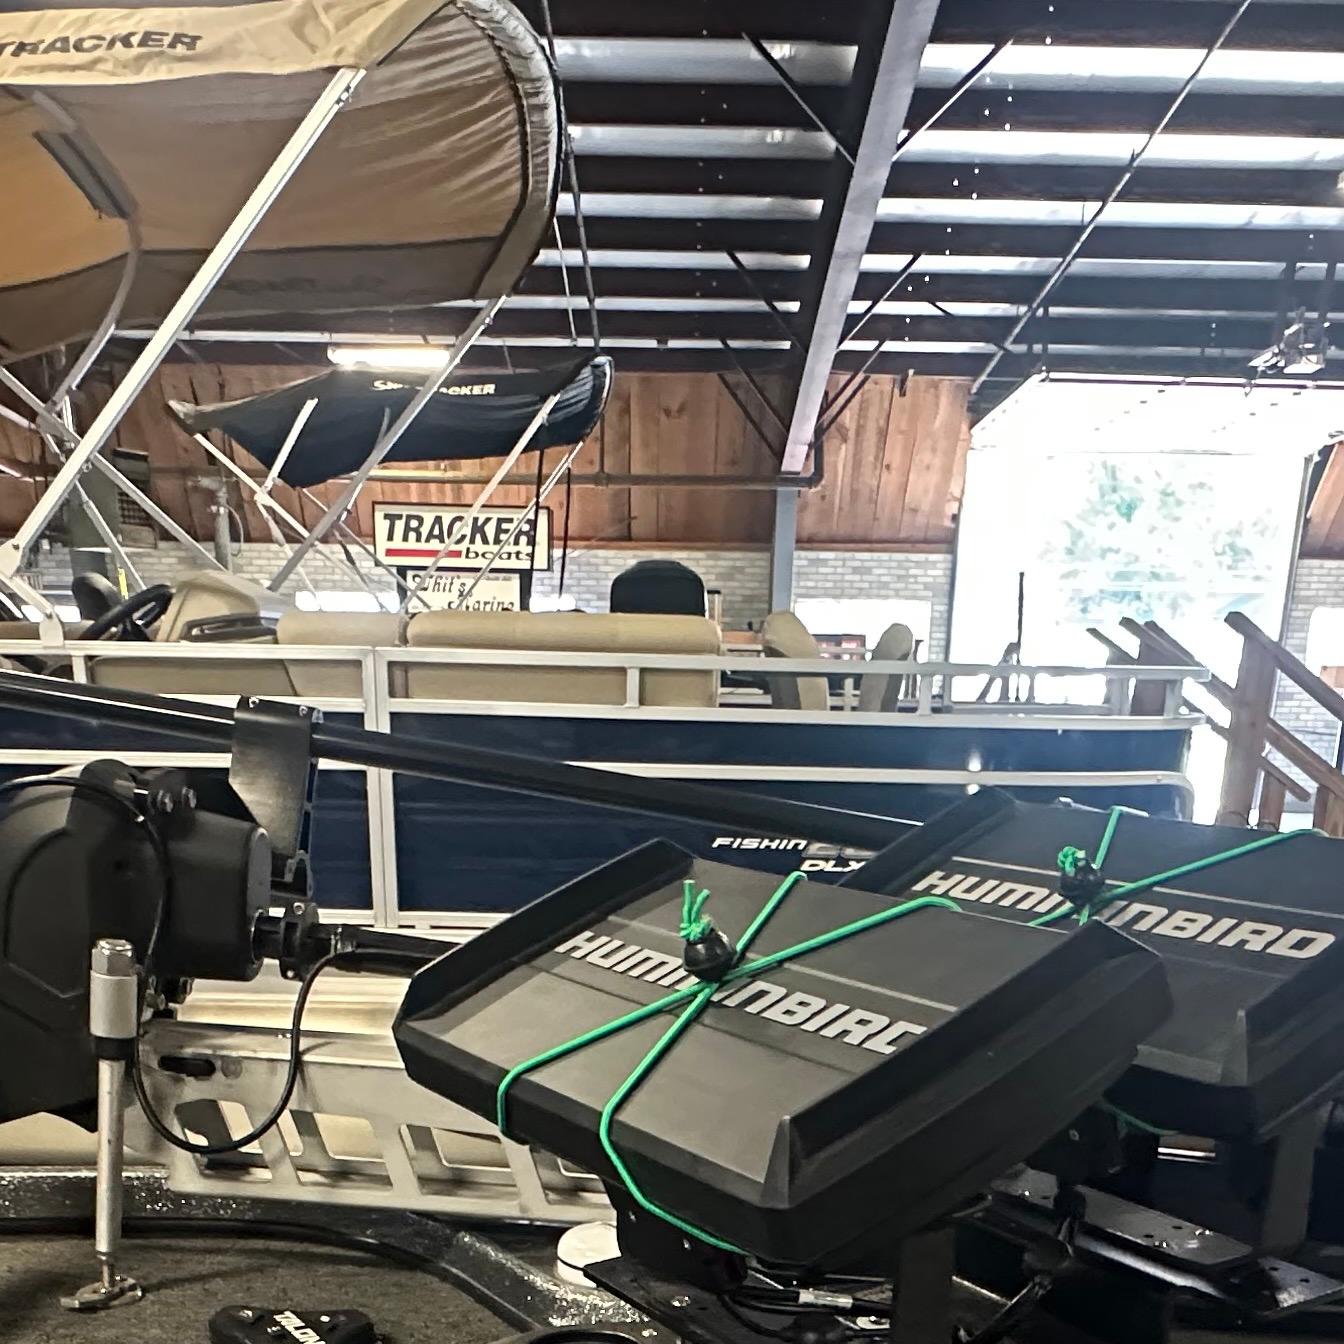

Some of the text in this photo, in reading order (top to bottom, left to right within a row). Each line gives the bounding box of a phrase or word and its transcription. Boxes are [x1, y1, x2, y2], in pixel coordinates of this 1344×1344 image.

[383, 513, 535, 546] TRACKER
[464, 546, 534, 561] boats
[799, 859, 866, 873] DLX
